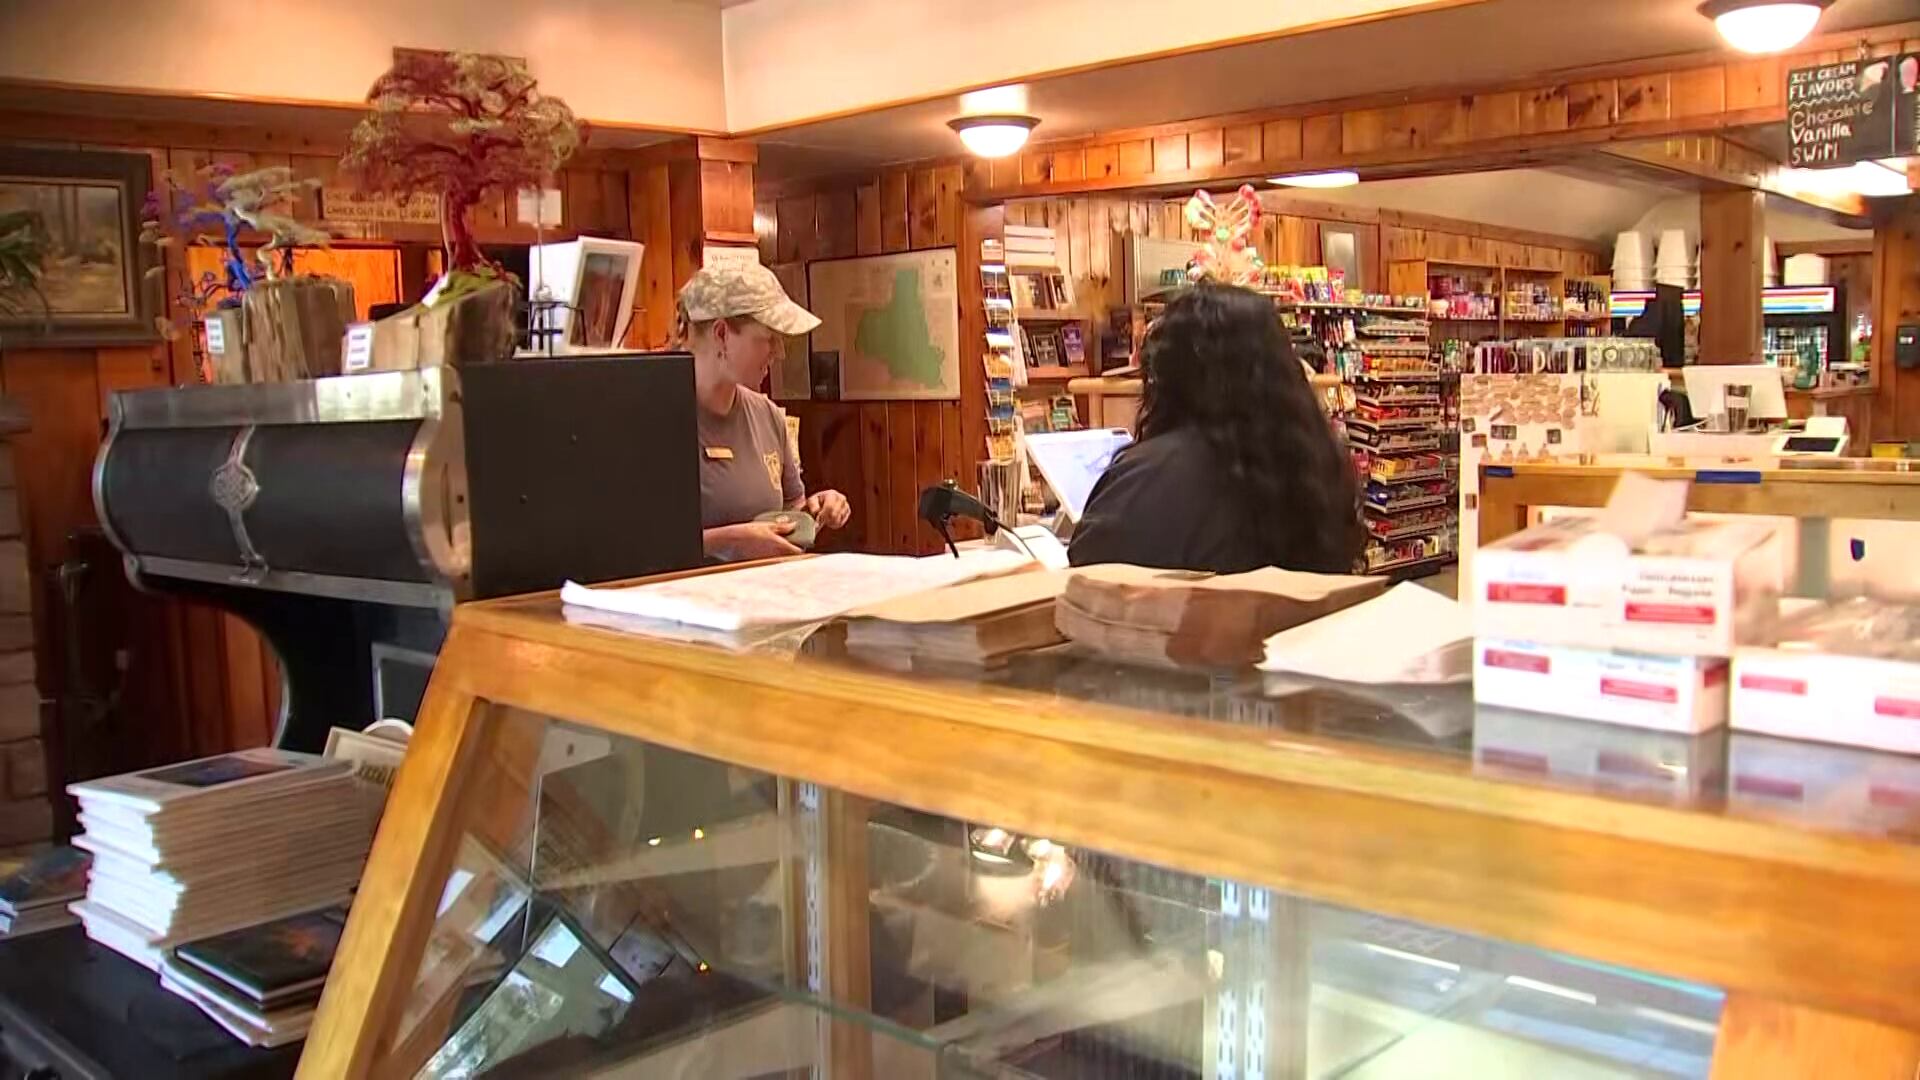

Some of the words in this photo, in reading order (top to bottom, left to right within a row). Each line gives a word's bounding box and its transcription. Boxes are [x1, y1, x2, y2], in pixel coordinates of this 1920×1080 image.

[1817, 63, 1857, 80] CREAM
[1790, 77, 1855, 100] FLAVORS
[1791, 101, 1874, 129] Chocolate
[1790, 121, 1852, 145] Vanilla
